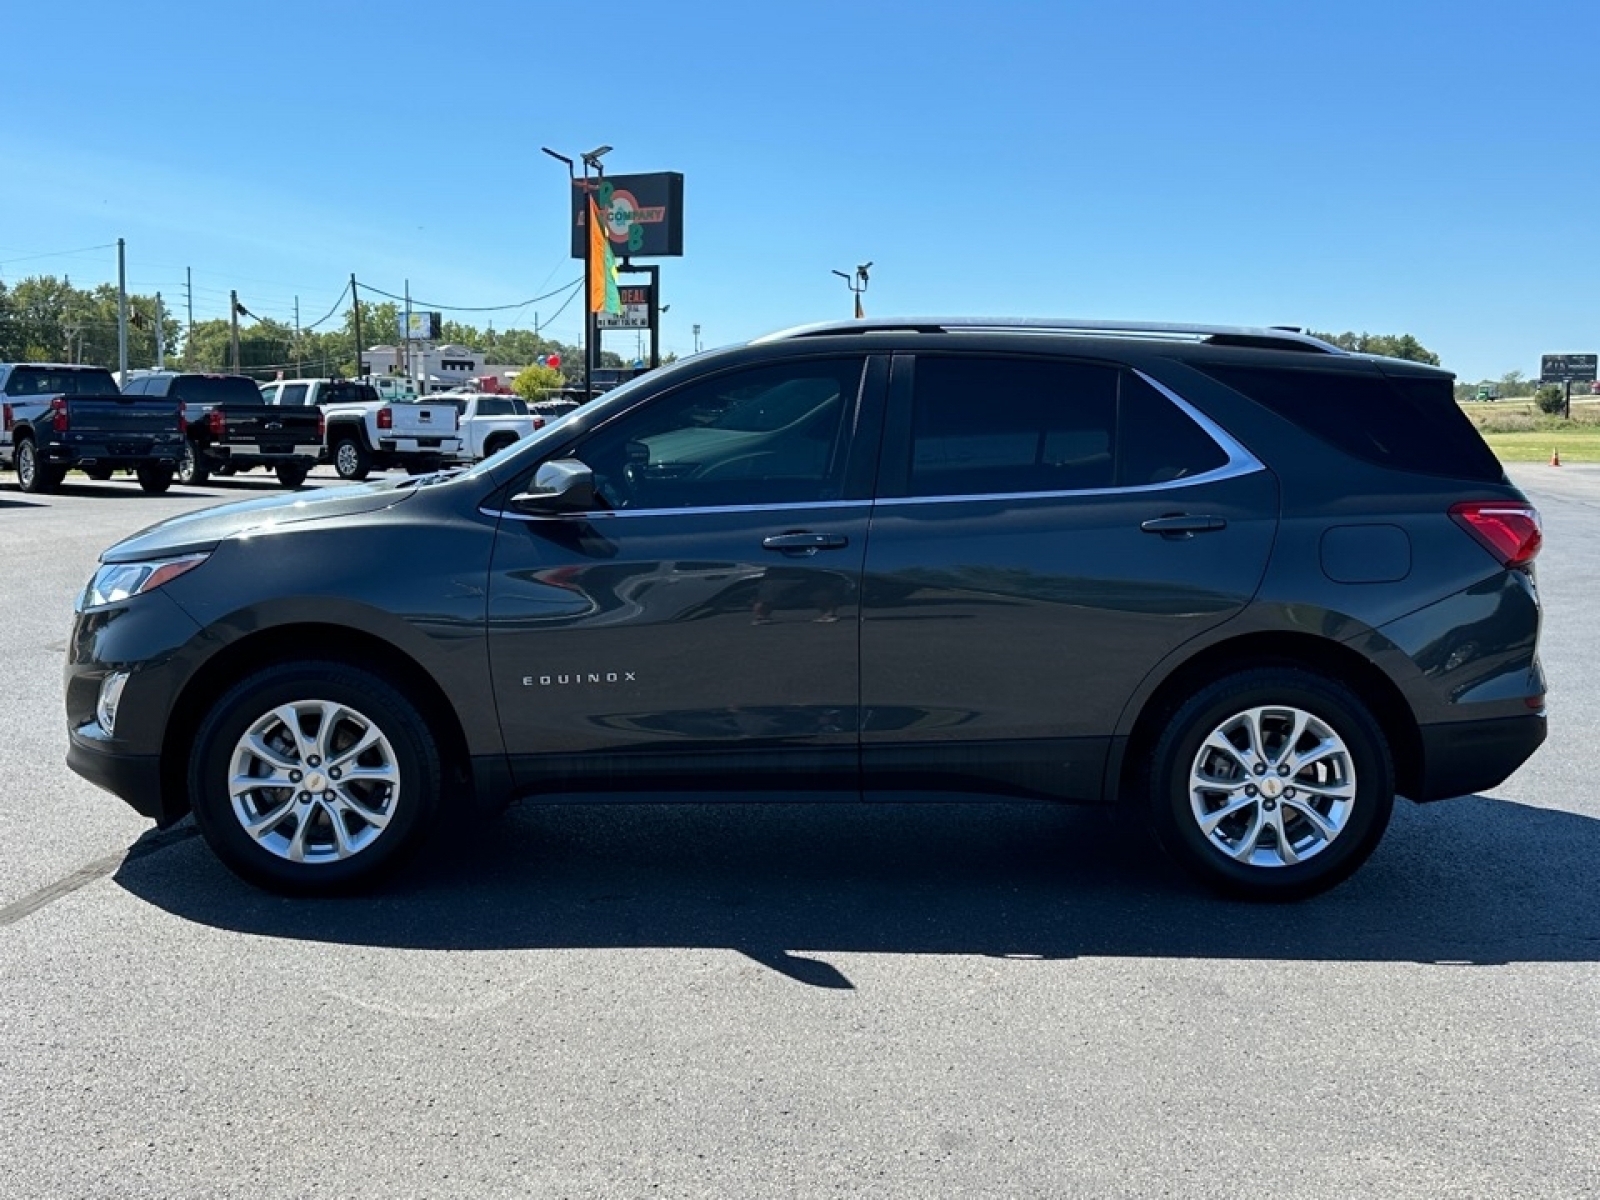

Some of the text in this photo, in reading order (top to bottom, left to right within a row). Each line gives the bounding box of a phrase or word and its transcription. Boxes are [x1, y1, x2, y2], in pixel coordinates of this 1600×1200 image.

[607, 209, 663, 222] COMPANY
[628, 223, 644, 252] B
[621, 289, 646, 303] DEAL
[522, 671, 636, 686] EQUINOX
